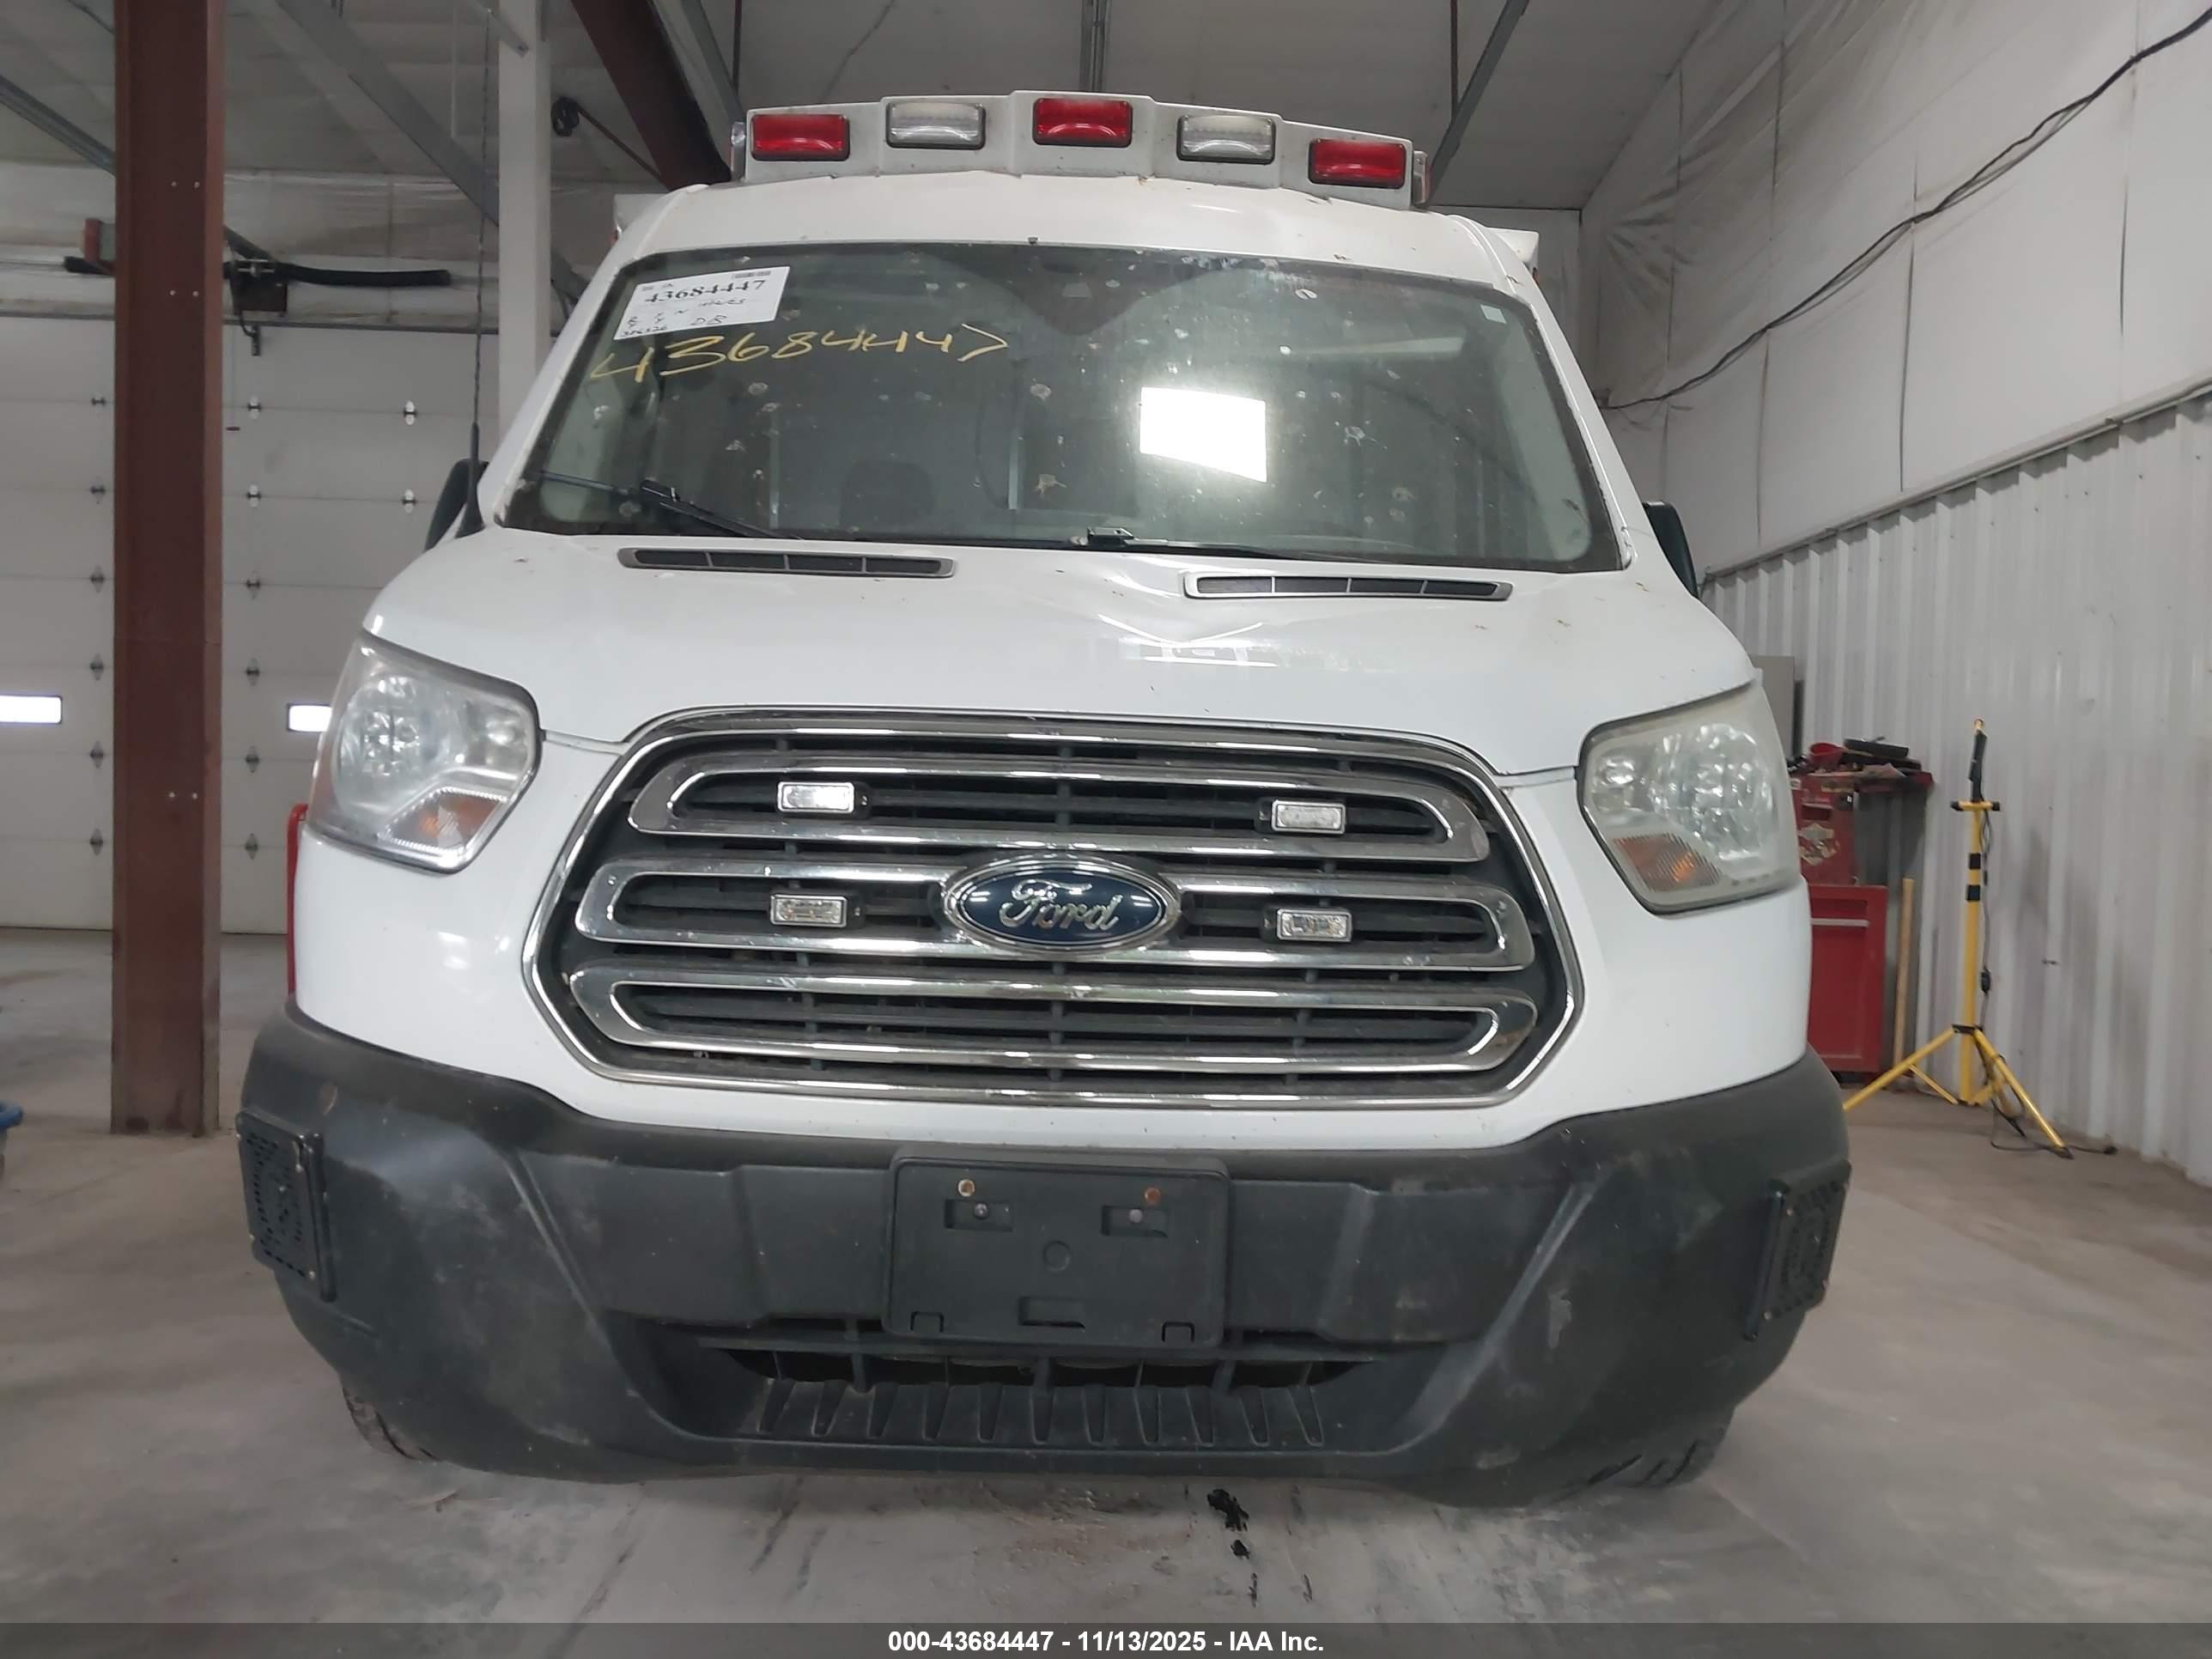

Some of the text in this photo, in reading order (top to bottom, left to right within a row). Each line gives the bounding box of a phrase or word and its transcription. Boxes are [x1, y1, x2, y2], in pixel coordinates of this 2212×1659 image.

[645, 279, 767, 304] 43684447
[590, 323, 1009, 383] 43684447
[998, 878, 1124, 931] Ford
